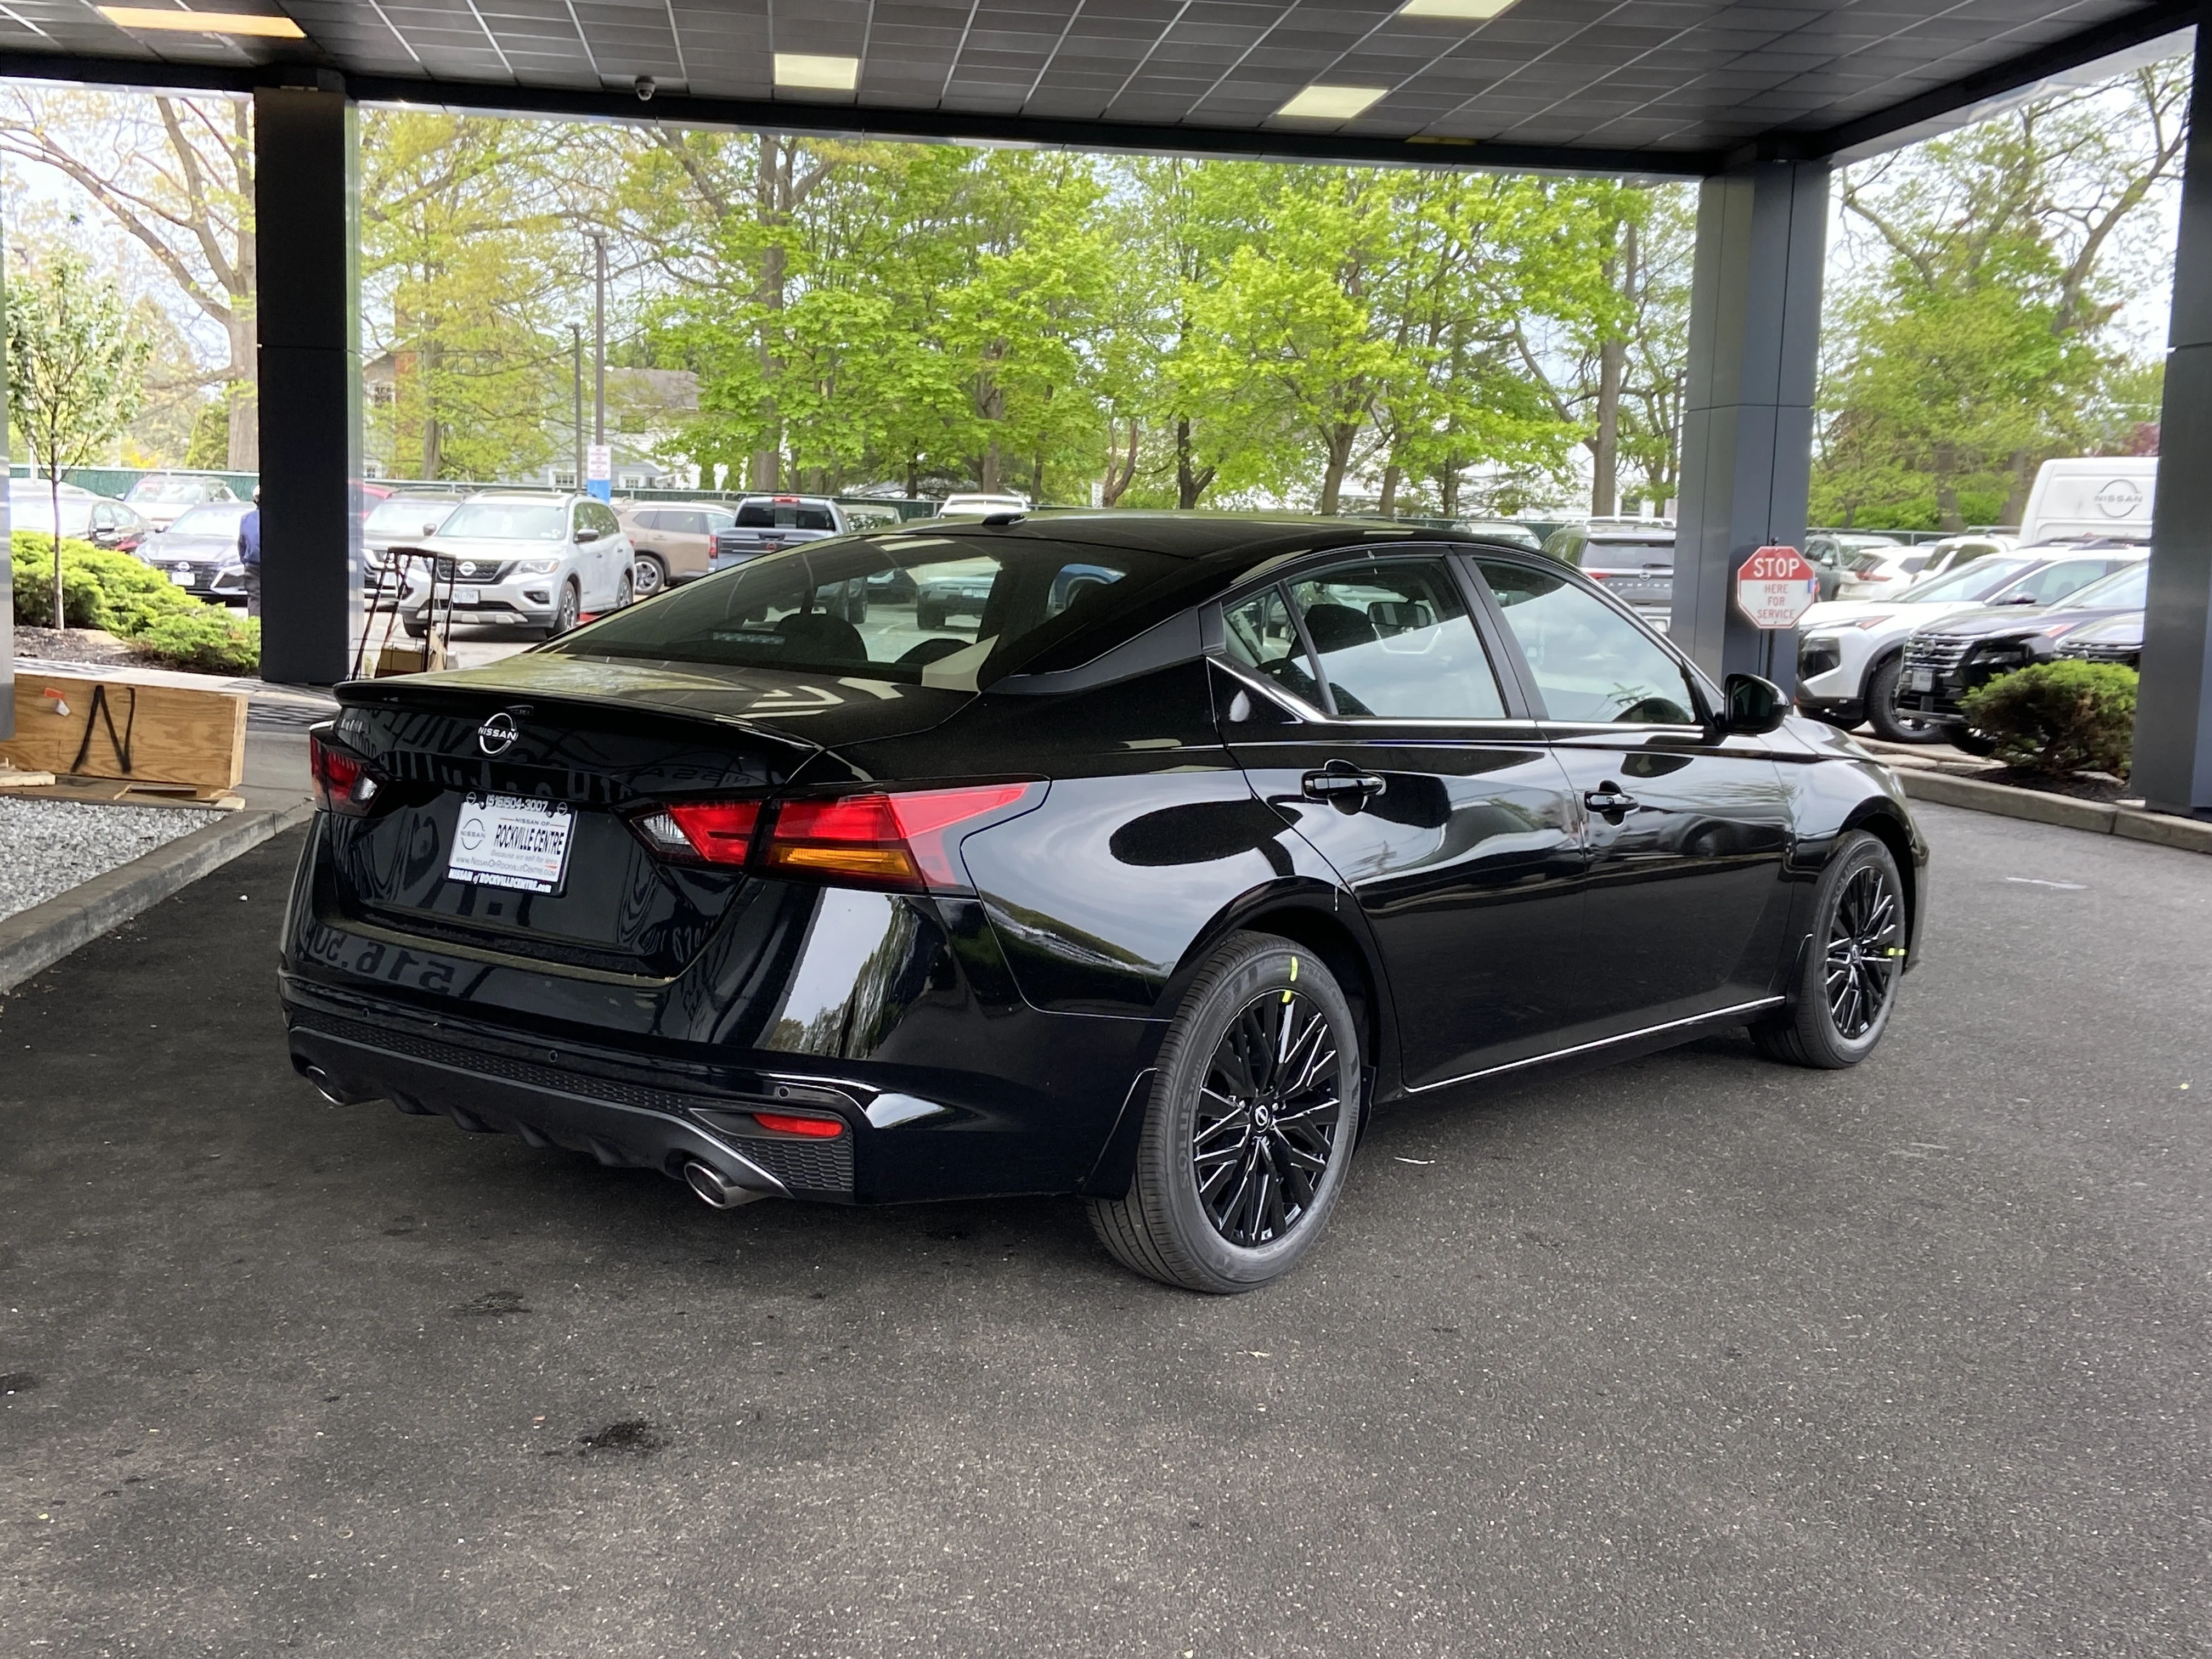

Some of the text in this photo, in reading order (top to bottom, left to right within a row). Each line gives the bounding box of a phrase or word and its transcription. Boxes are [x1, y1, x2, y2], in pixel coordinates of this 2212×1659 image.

[1753, 557, 1800, 578] STOP
[1764, 584, 1789, 594] HERE
[1768, 597, 1785, 606] FOR
[1757, 609, 1796, 619] SERVICE
[70, 685, 136, 774] N
[477, 726, 519, 741] NISSAN
[460, 830, 486, 839] NISSAN
[494, 824, 565, 855] ROCKVILLE CENTRE
[490, 849, 515, 859] Because
[448, 868, 473, 882] NISSAN
[1178, 1092, 1192, 1189] SOLUS
